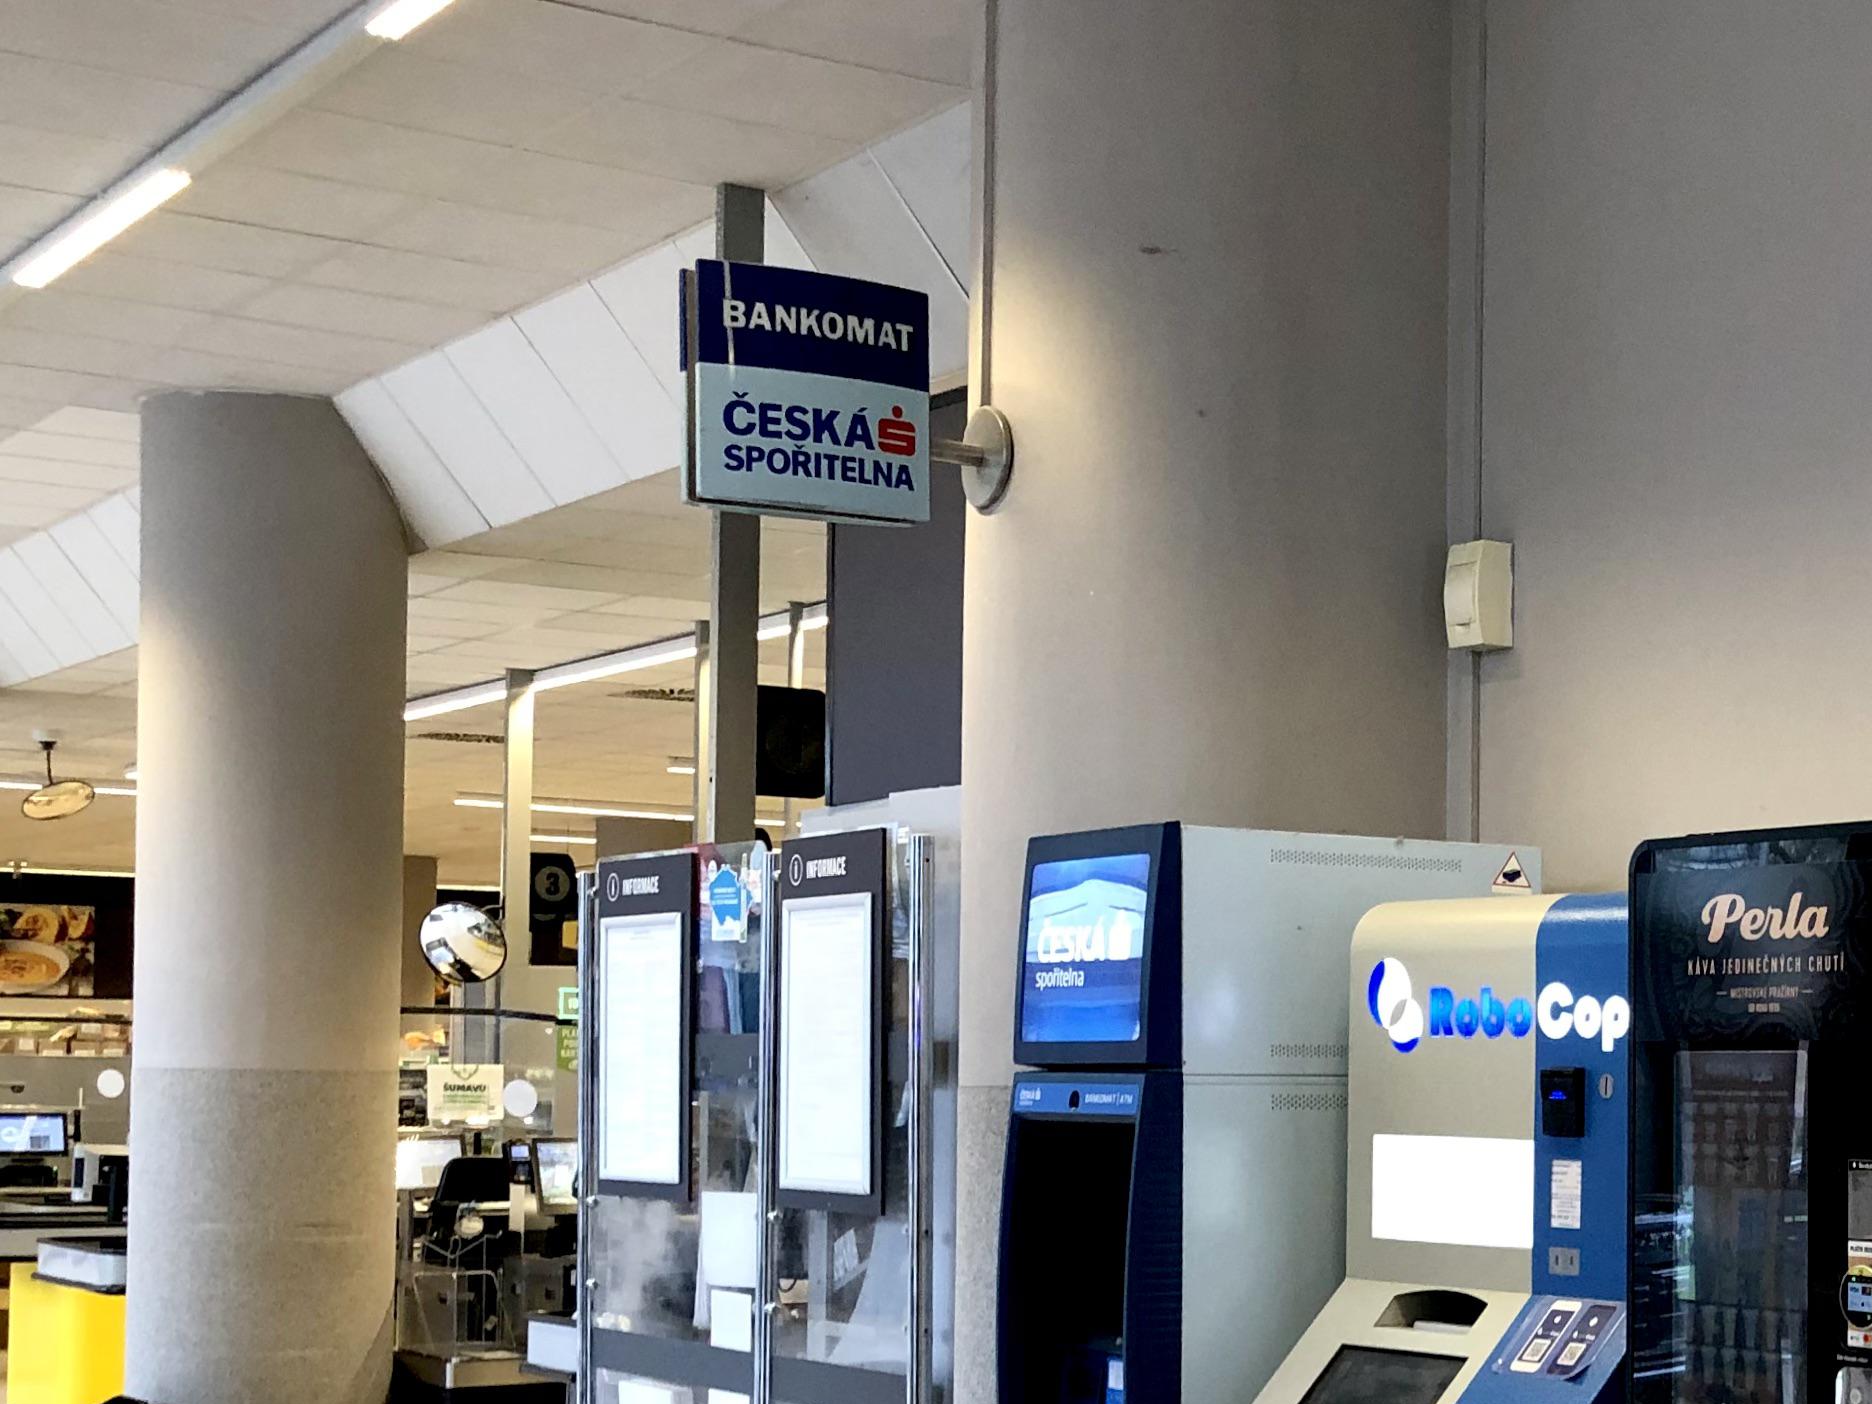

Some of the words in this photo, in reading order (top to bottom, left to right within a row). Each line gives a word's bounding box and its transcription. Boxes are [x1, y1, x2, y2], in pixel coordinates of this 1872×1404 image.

[723, 299, 913, 351] BANKOMAT
[723, 391, 875, 450] ČESKÁ
[723, 444, 914, 491] SPOŘITELNA
[545, 872, 560, 896] 3
[622, 876, 660, 895] INFORMACE
[806, 856, 847, 879] INFORMACE
[1701, 891, 1829, 943] Perla
[1035, 967, 1085, 991] spořitelna
[1687, 956, 1716, 976] KÁVA
[1722, 953, 1801, 975] JEDINEČNÝCH
[1808, 951, 1844, 972] CHUTÍ
[1428, 981, 1630, 1053] RoboCop
